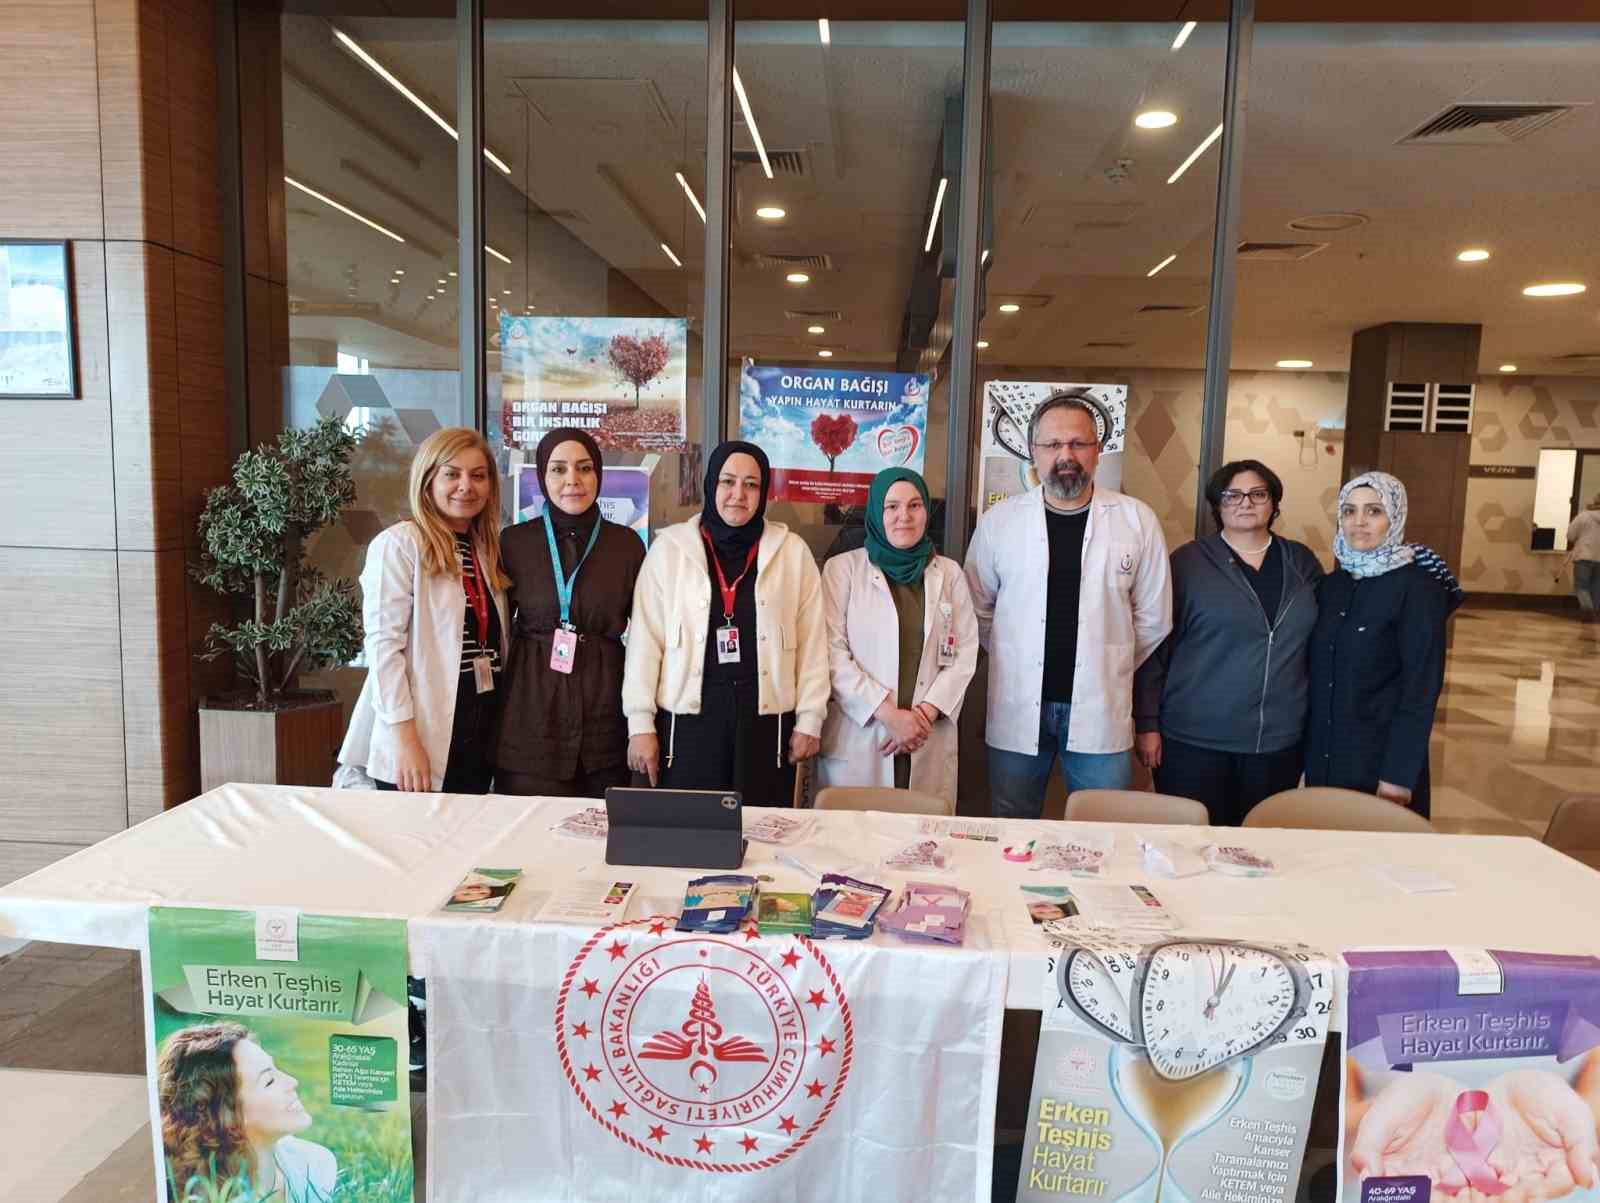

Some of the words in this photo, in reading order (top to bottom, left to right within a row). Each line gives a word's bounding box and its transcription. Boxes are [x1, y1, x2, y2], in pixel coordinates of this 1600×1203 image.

[781, 375, 834, 391] ORGAN
[841, 377, 888, 396] BAĞIŞI
[512, 401, 558, 413] ORGAN
[561, 400, 608, 416] BAĞIŞI
[770, 396, 801, 406] YAPIN
[806, 397, 840, 409] HAYAT
[843, 399, 897, 411] KURTARIN
[206, 967, 267, 990] Erken
[273, 972, 342, 996] Teşhis
[208, 989, 266, 1010] Hayat
[269, 993, 343, 1014] Kurtarır.
[609, 957, 661, 1058] BAKANLIĞI
[746, 961, 798, 1041] TÜRKİYE
[1156, 1000, 1165, 1012] 8
[1294, 1026, 1317, 1040] 30
[1401, 1012, 1468, 1035] Erken
[1475, 1010, 1551, 1036] Teşhis
[1175, 1047, 1184, 1059] 6
[1401, 1037, 1462, 1059] Hayat
[618, 1063, 680, 1115] SAĞLIK
[686, 1047, 797, 1121] CUMHURİYETİ
[1040, 1098, 1110, 1126] Erken
[1037, 1121, 1113, 1152] Teşhis
[1230, 1117, 1261, 1130] Erken
[1264, 1119, 1297, 1134] Teşhis
[1244, 1131, 1294, 1146] Amacıyla
[1032, 1144, 1097, 1173] Hayat
[1253, 1143, 1290, 1157] Kanser
[1220, 1178, 1258, 1191] KETEM
[1260, 1184, 1285, 1195] veya
